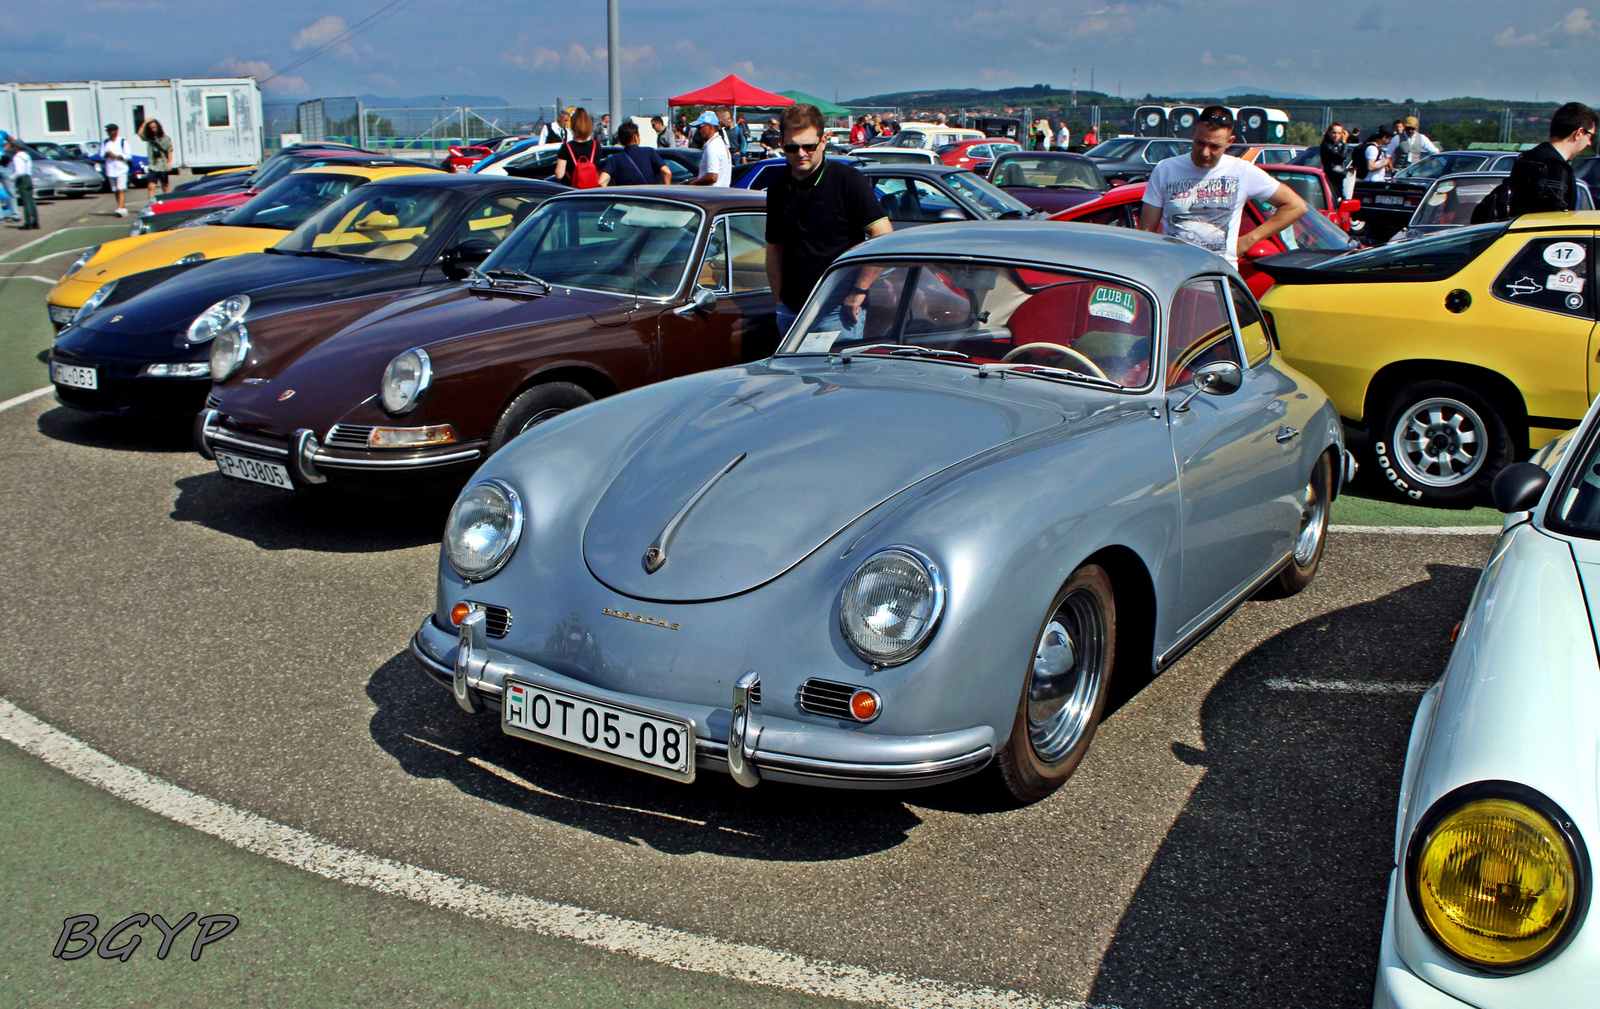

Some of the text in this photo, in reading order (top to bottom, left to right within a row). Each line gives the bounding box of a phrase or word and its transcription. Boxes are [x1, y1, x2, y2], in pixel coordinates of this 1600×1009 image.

[1555, 248, 1574, 260] 17
[1558, 274, 1574, 284] 50
[1096, 287, 1122, 303] CLUB
[224, 455, 285, 486] P-03805
[1375, 441, 1423, 500] P3000
[602, 607, 681, 630] PORSCHE
[510, 704, 522, 723] H
